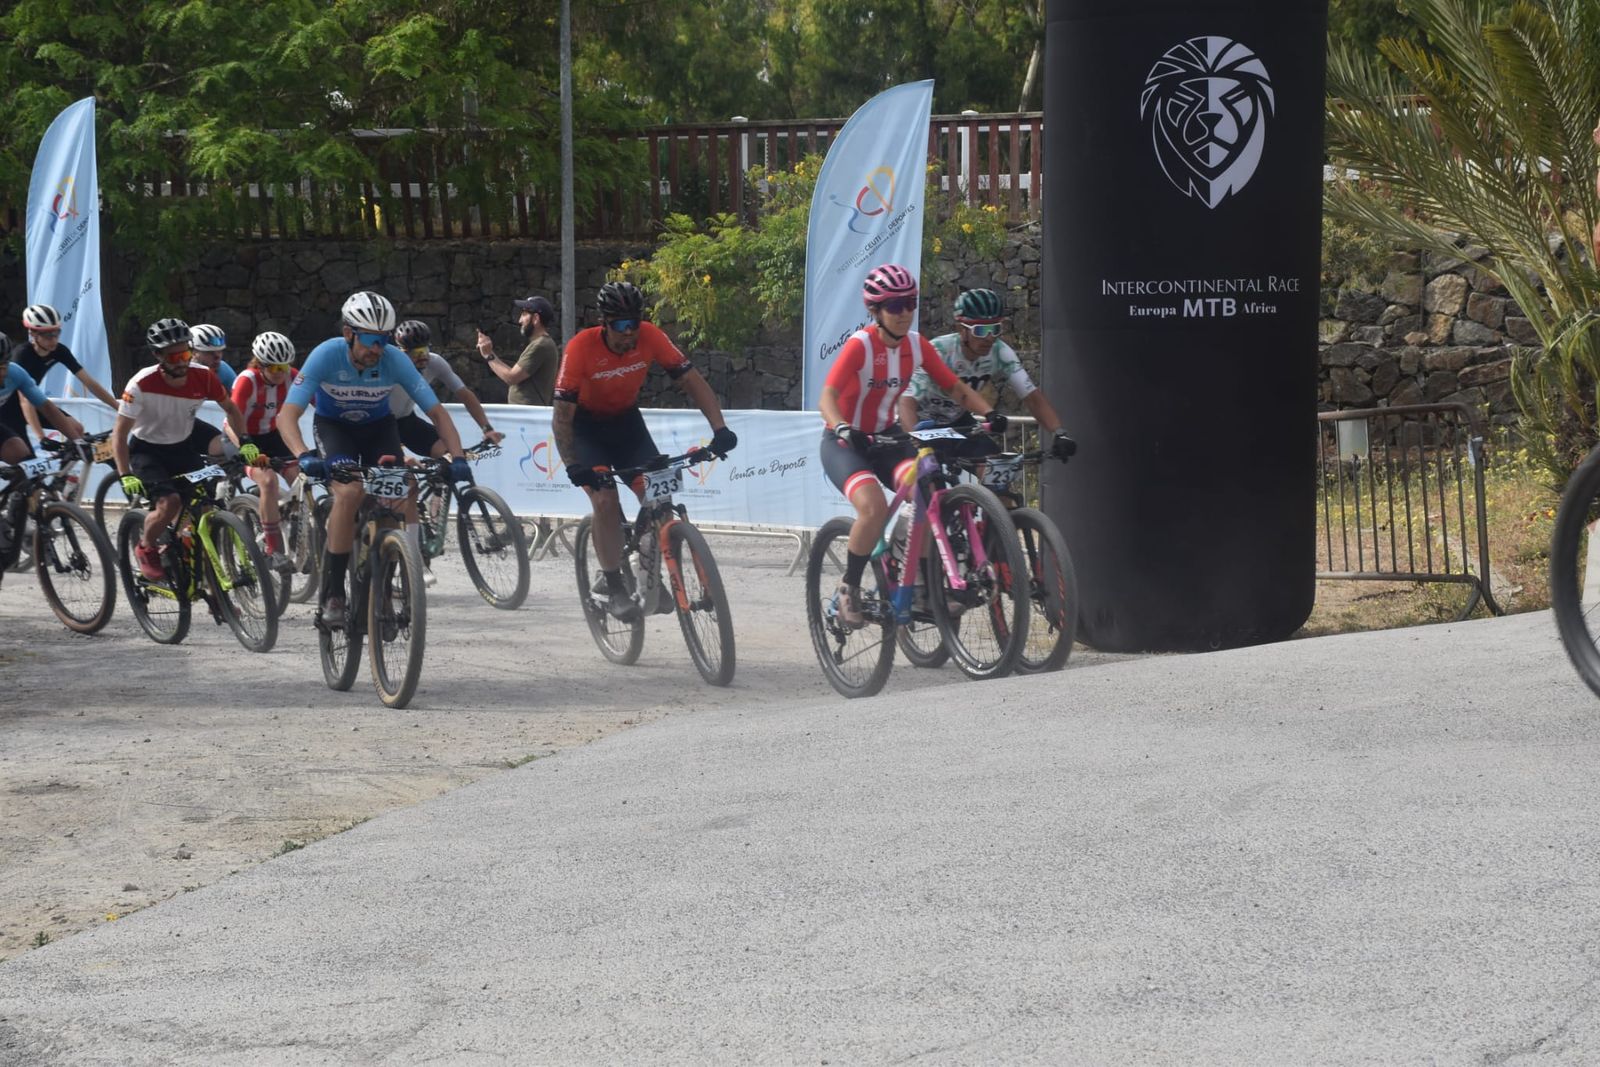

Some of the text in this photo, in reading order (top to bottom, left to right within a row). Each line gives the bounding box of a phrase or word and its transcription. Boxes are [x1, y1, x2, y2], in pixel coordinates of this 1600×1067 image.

[1129, 297, 1277, 318] Europa MTB Africa
[330, 388, 349, 398] SAN
[373, 480, 404, 496] 256
[651, 478, 679, 497] 233
